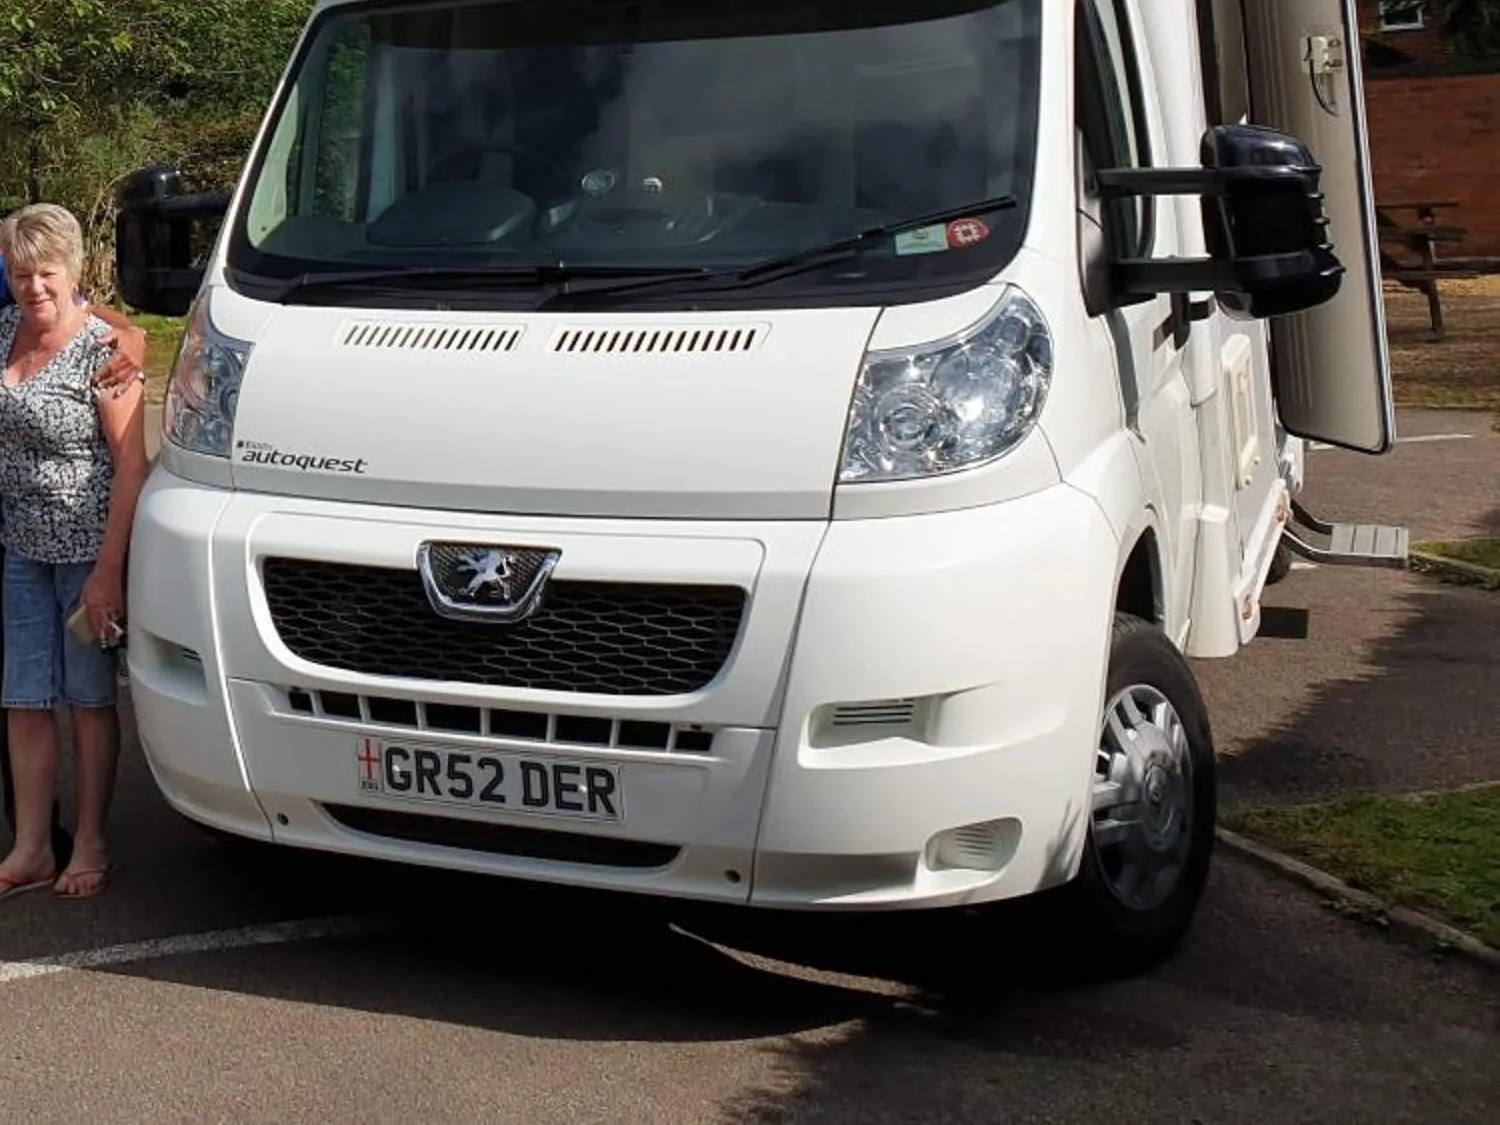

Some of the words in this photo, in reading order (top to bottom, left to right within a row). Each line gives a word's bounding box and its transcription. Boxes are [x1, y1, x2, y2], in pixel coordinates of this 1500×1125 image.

[242, 449, 368, 473] autoquest
[385, 747, 506, 803] GR52
[520, 761, 616, 814] DER
